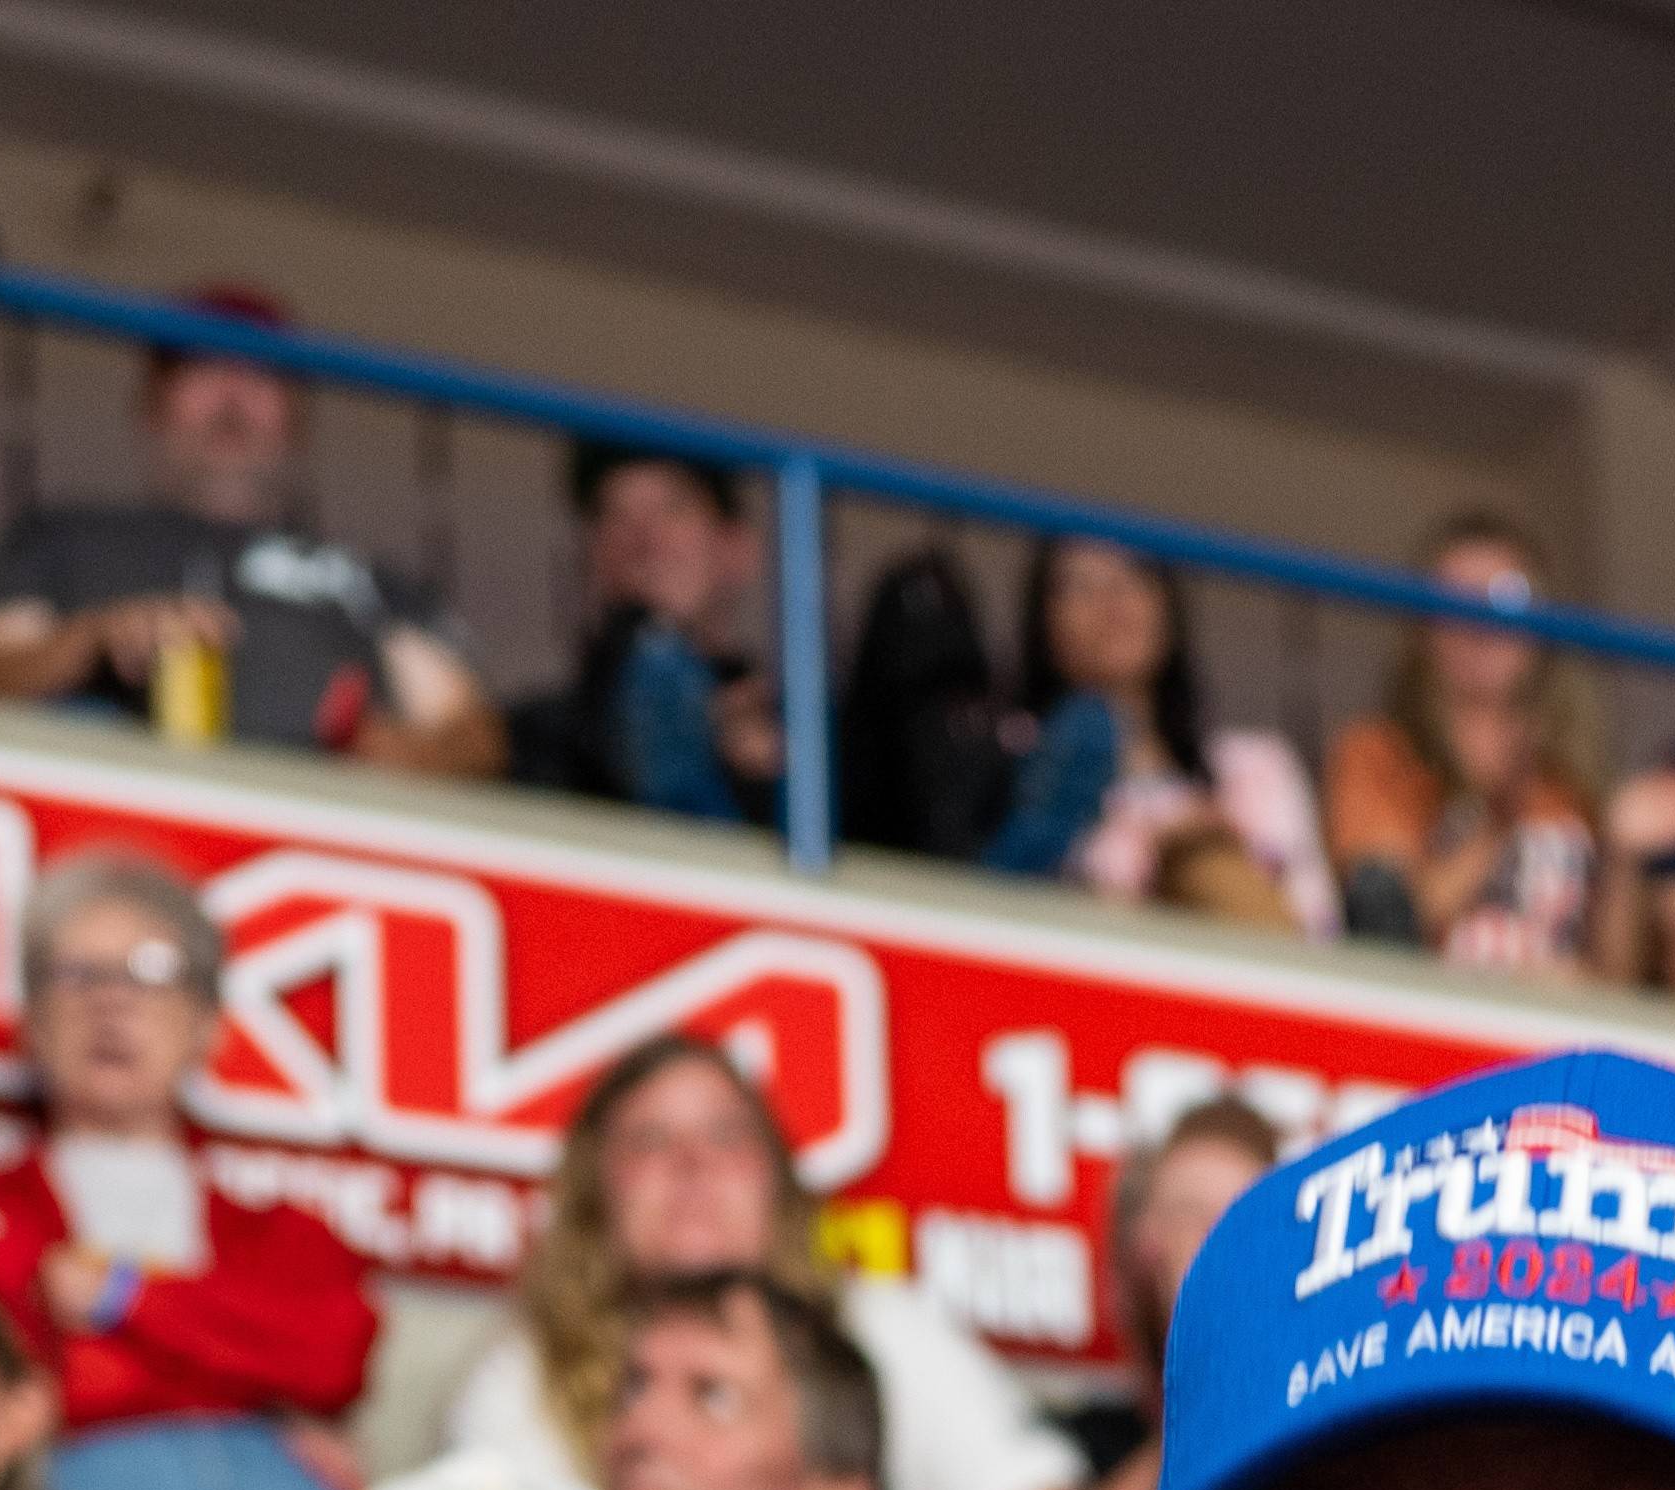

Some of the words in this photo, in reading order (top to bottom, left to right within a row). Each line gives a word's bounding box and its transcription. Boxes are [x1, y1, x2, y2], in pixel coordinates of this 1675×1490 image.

[1445, 1238, 1647, 1313] 2024
[1286, 1322, 1388, 1409] SAVE
[1405, 1304, 1628, 1368] AMERICA
